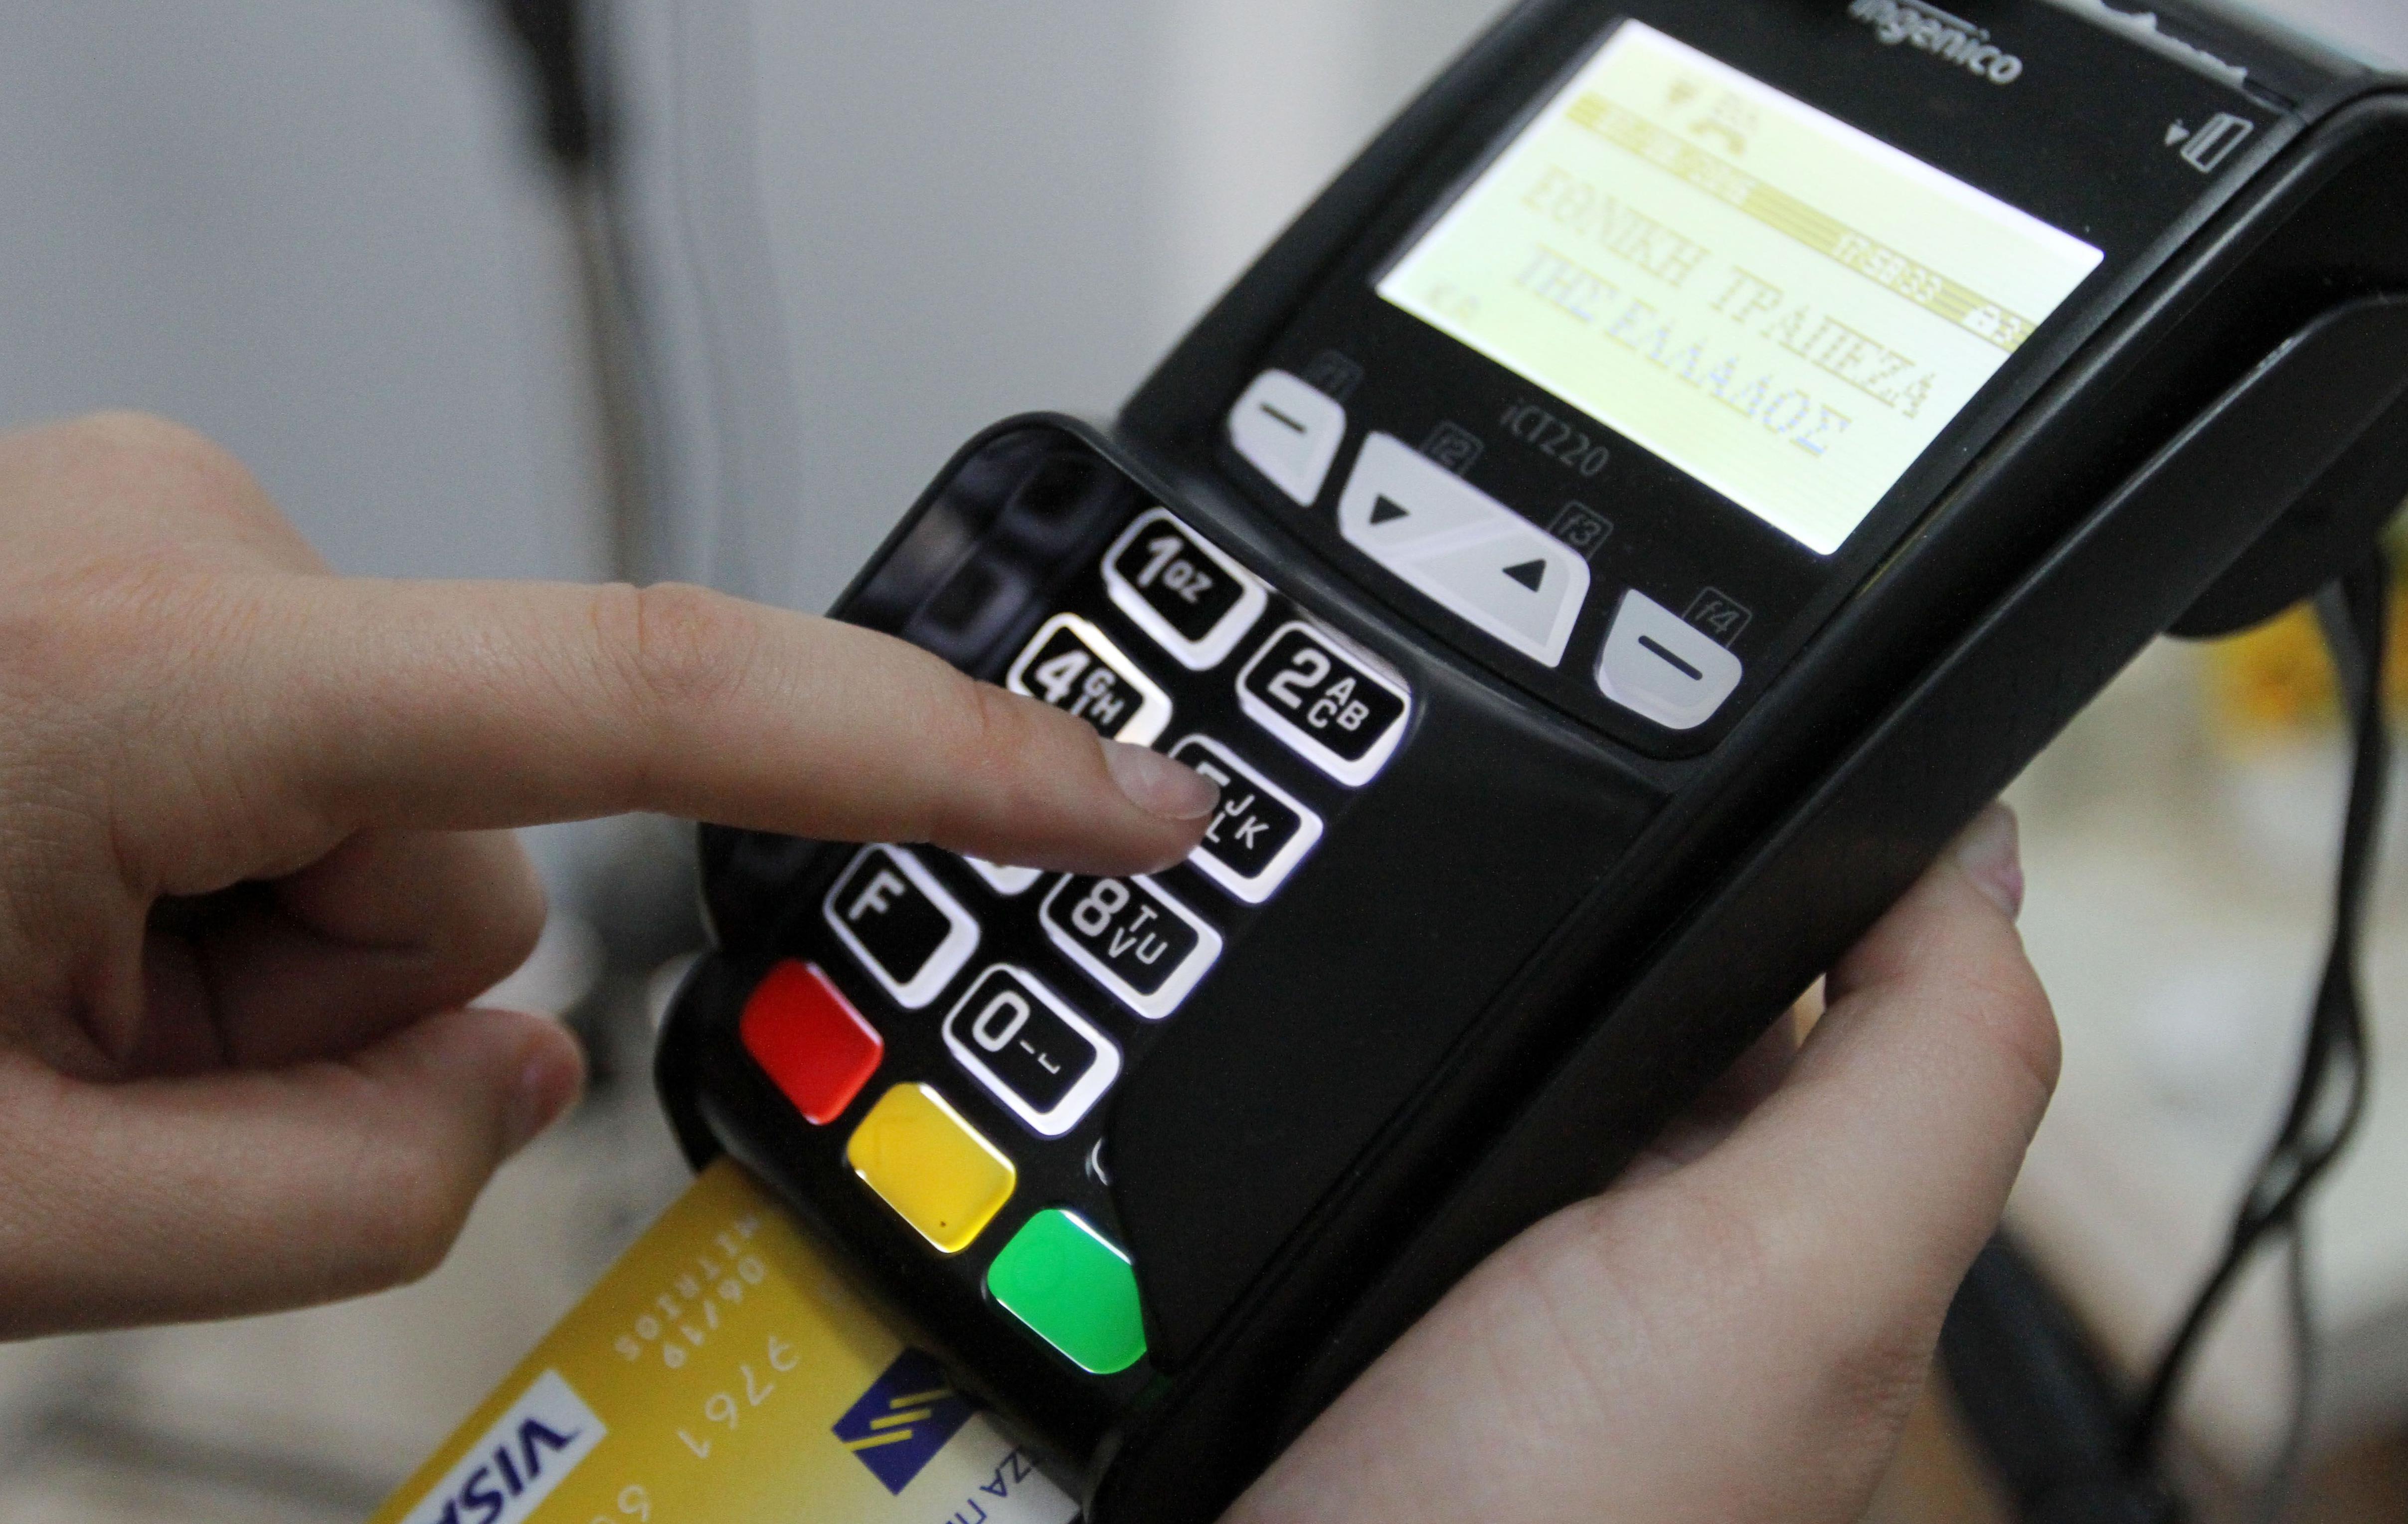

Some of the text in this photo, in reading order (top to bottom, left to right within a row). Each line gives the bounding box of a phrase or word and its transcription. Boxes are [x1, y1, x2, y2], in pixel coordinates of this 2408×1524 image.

[1522, 165, 1937, 419] ΕΘΝΙΚΗ ΤΡΑΠΕΖΑ
[1514, 243, 1852, 458] ΤΗΣ ΕΛΛΑΔΟΣ
[1500, 399, 1611, 478] iCT220
[1558, 514, 1601, 547] f3
[1696, 599, 1739, 634] f4
[848, 870, 906, 922] F
[676, 1334, 801, 1460] 9761
